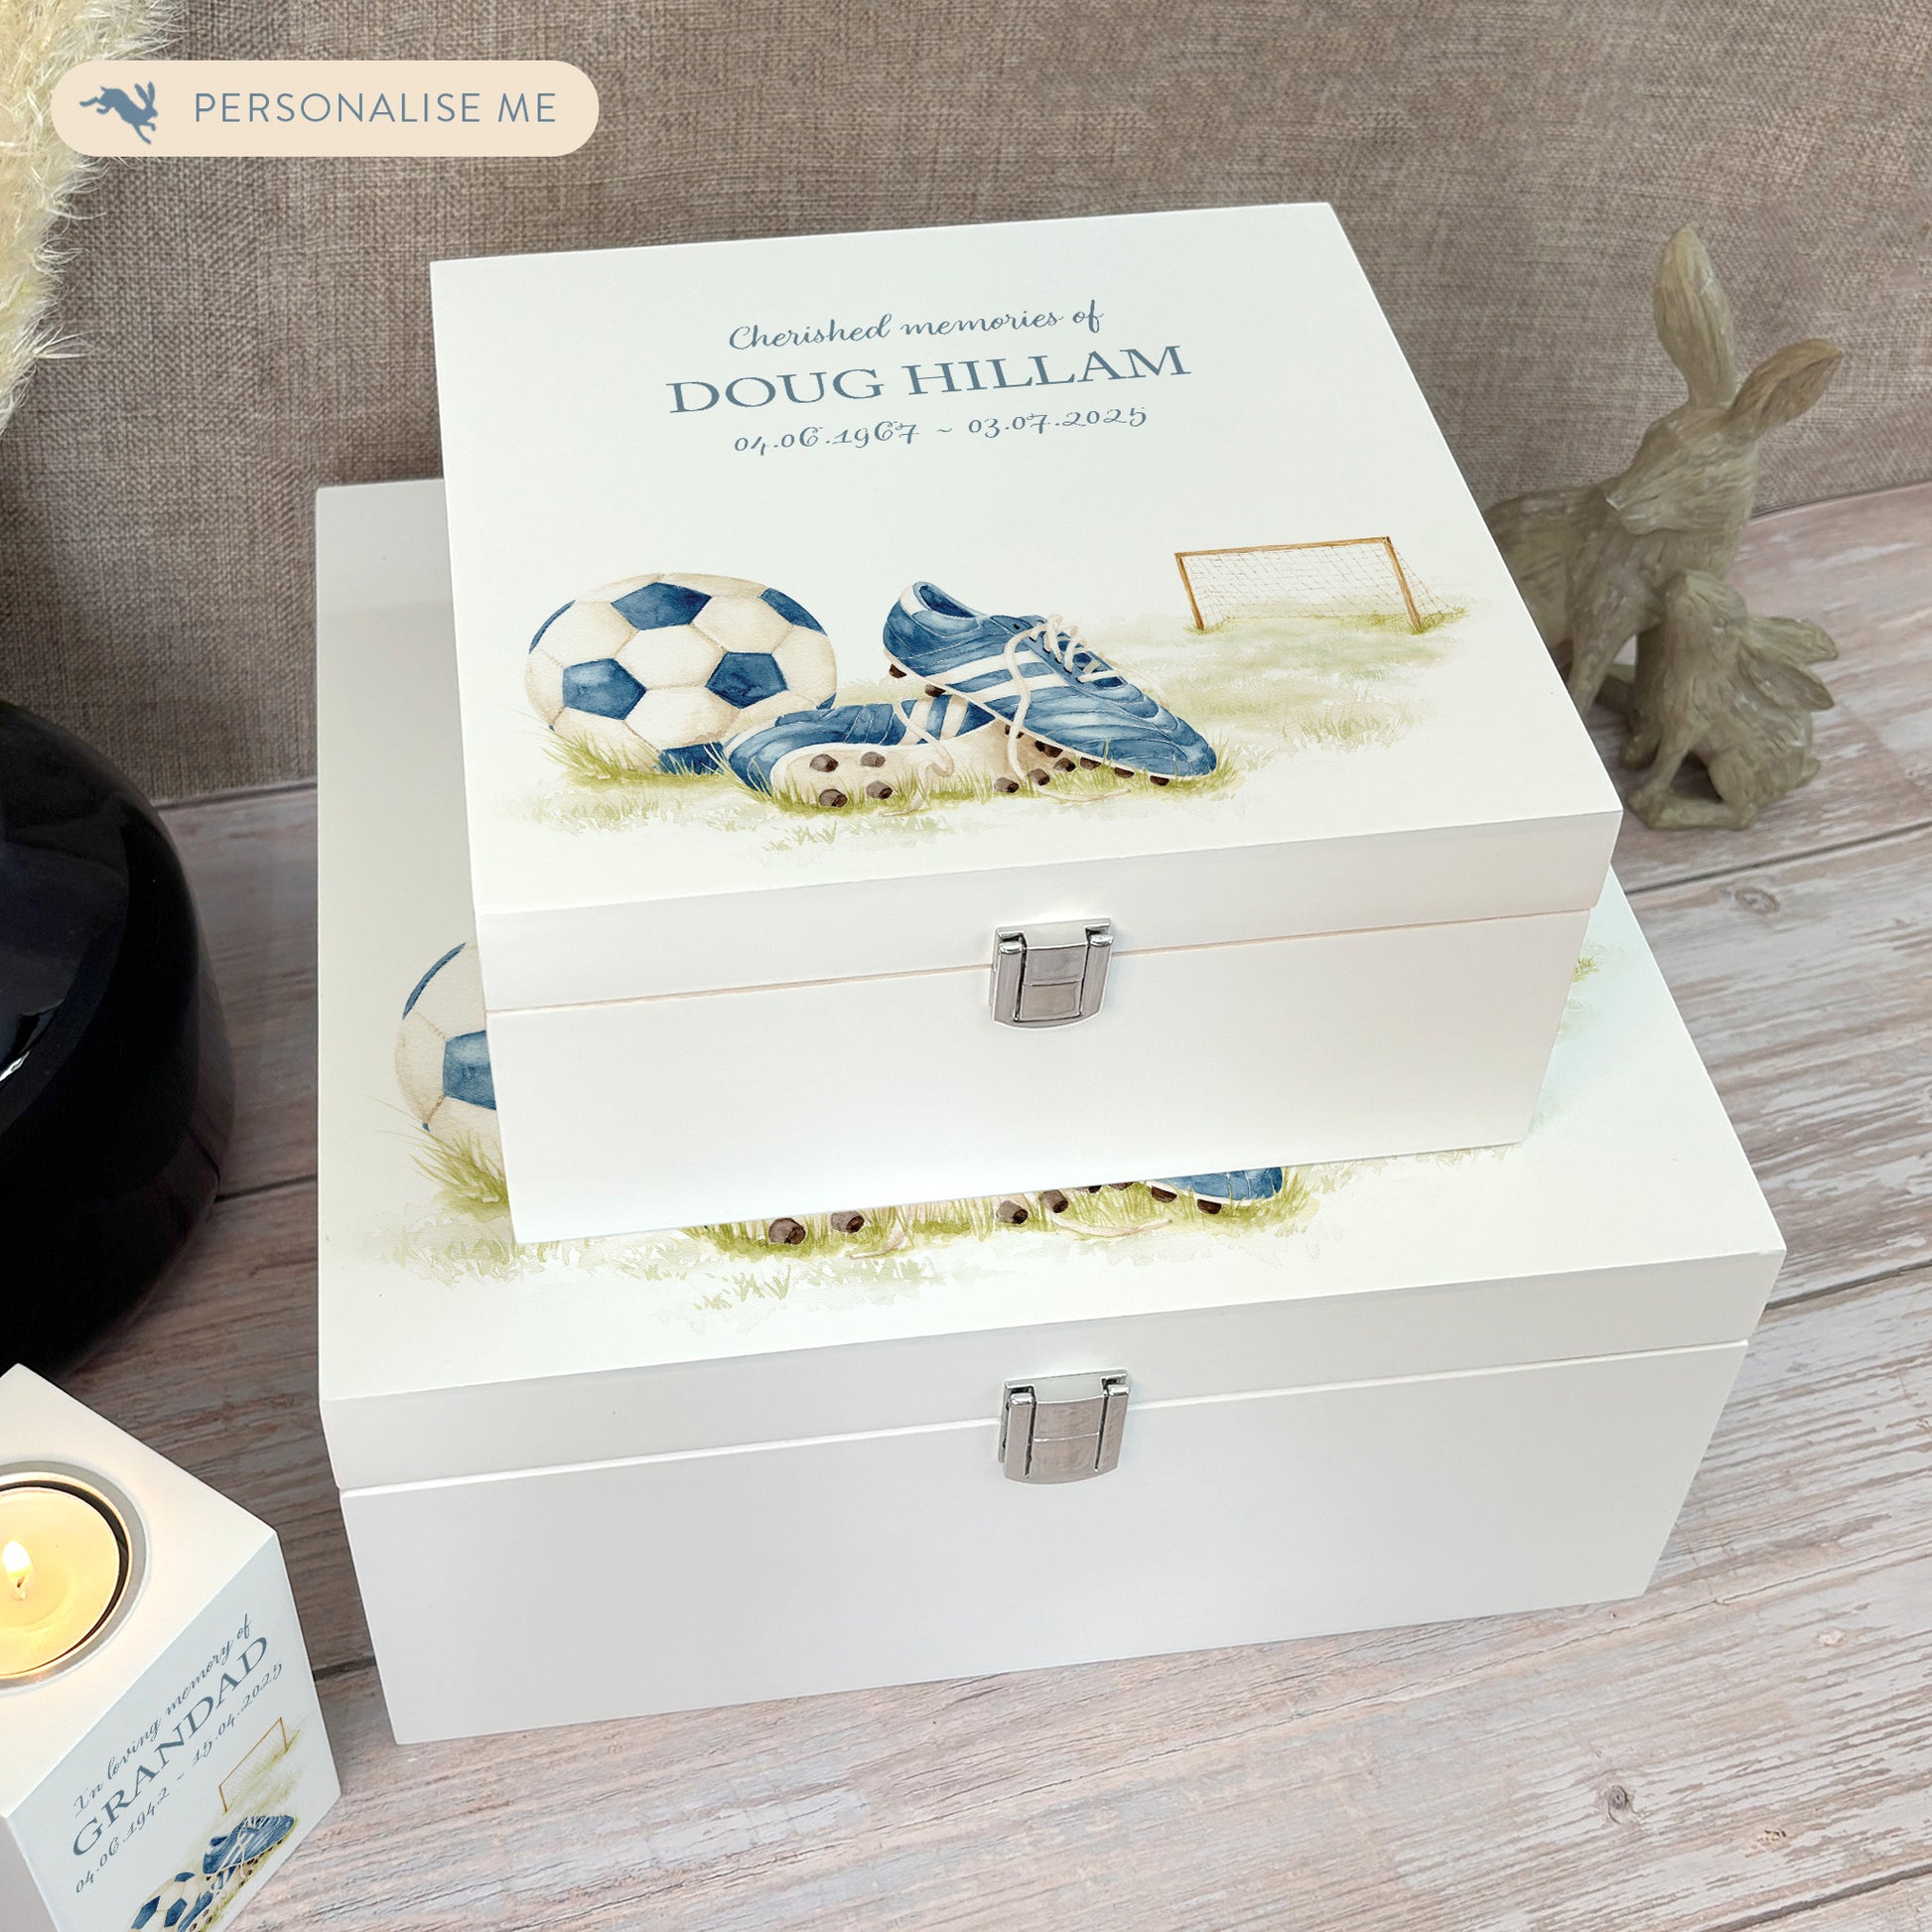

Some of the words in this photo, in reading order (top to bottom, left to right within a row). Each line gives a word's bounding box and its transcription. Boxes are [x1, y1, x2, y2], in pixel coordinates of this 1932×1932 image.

[666, 368, 885, 414] DOUG
[901, 345, 1191, 396] HILLAM
[728, 313, 892, 350] Cherished
[899, 309, 1064, 337] memories
[1072, 299, 1105, 334] of
[734, 421, 920, 457] 04.06.1967
[968, 406, 1148, 439] 03.07.2025
[72, 1636, 268, 1857] GRANDAD
[73, 1781, 104, 1819] In
[107, 1718, 162, 1779] loving
[165, 1638, 234, 1717] memory
[237, 1612, 252, 1640] of
[75, 1787, 170, 1893] 04.06.1942
[193, 1662, 284, 1767] 15.04.2025
